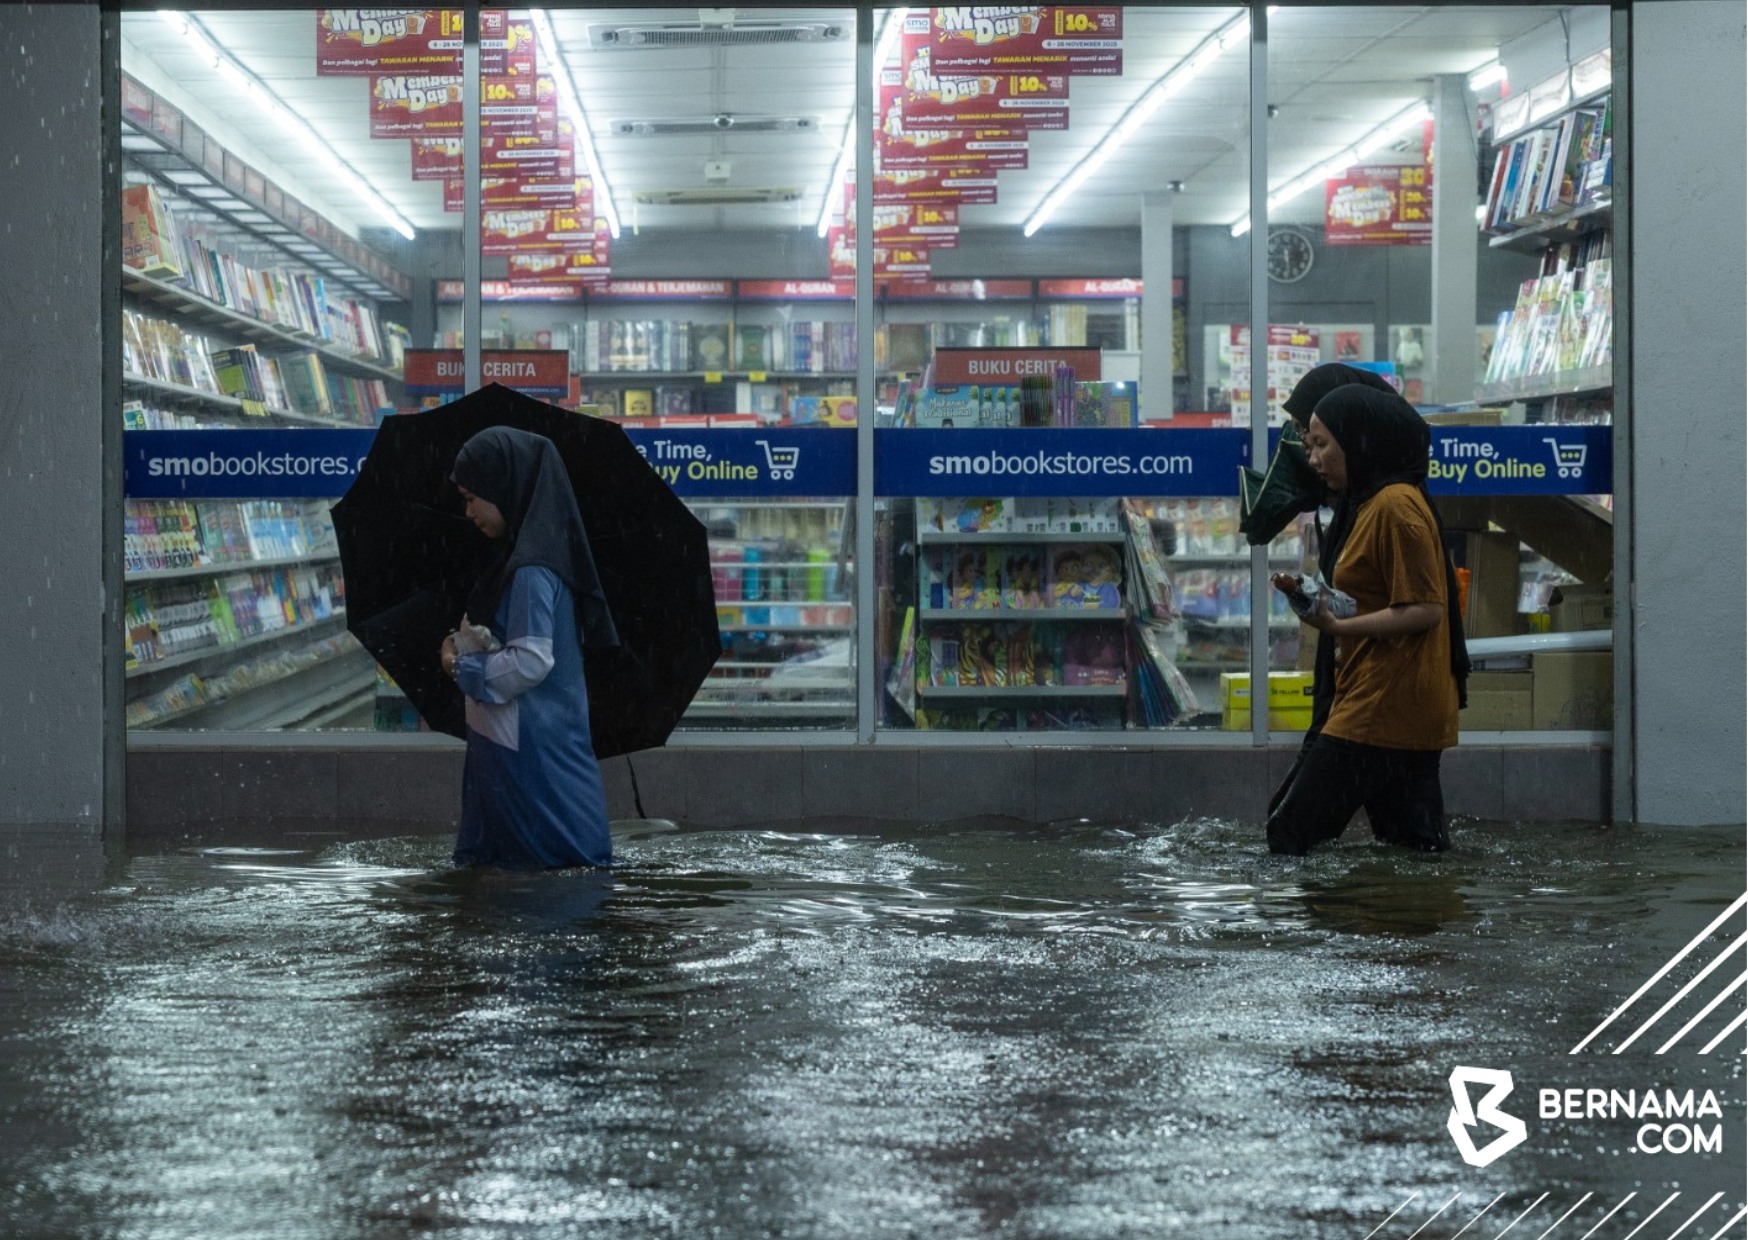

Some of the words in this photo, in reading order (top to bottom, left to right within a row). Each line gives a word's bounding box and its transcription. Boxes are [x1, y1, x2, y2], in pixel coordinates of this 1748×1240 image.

[361, 17, 407, 46] Day
[906, 19, 928, 27] smo
[974, 17, 1019, 44] Day
[1066, 13, 1098, 32] 10%
[380, 57, 418, 65] TAWARAN
[419, 55, 454, 64] MENARIK
[487, 83, 516, 100] 10%
[940, 79, 980, 104] Day
[1019, 76, 1048, 92] 10%
[408, 87, 447, 111] Day
[661, 281, 724, 294] TERJEMAHAN
[784, 282, 836, 294] AL-QURAN
[437, 362, 464, 376] BUK
[483, 361, 537, 377] CERITA
[968, 360, 1010, 374] BUKU
[1015, 359, 1068, 374] CERITA
[653, 440, 712, 461] Time,
[1440, 438, 1500, 460] Time,
[149, 452, 367, 476] smobookstores.c
[652, 464, 681, 485] uy
[687, 460, 758, 480] Online
[929, 450, 1193, 475] smobookstores.com
[1428, 459, 1468, 483] Buy
[1474, 458, 1546, 478] Online
